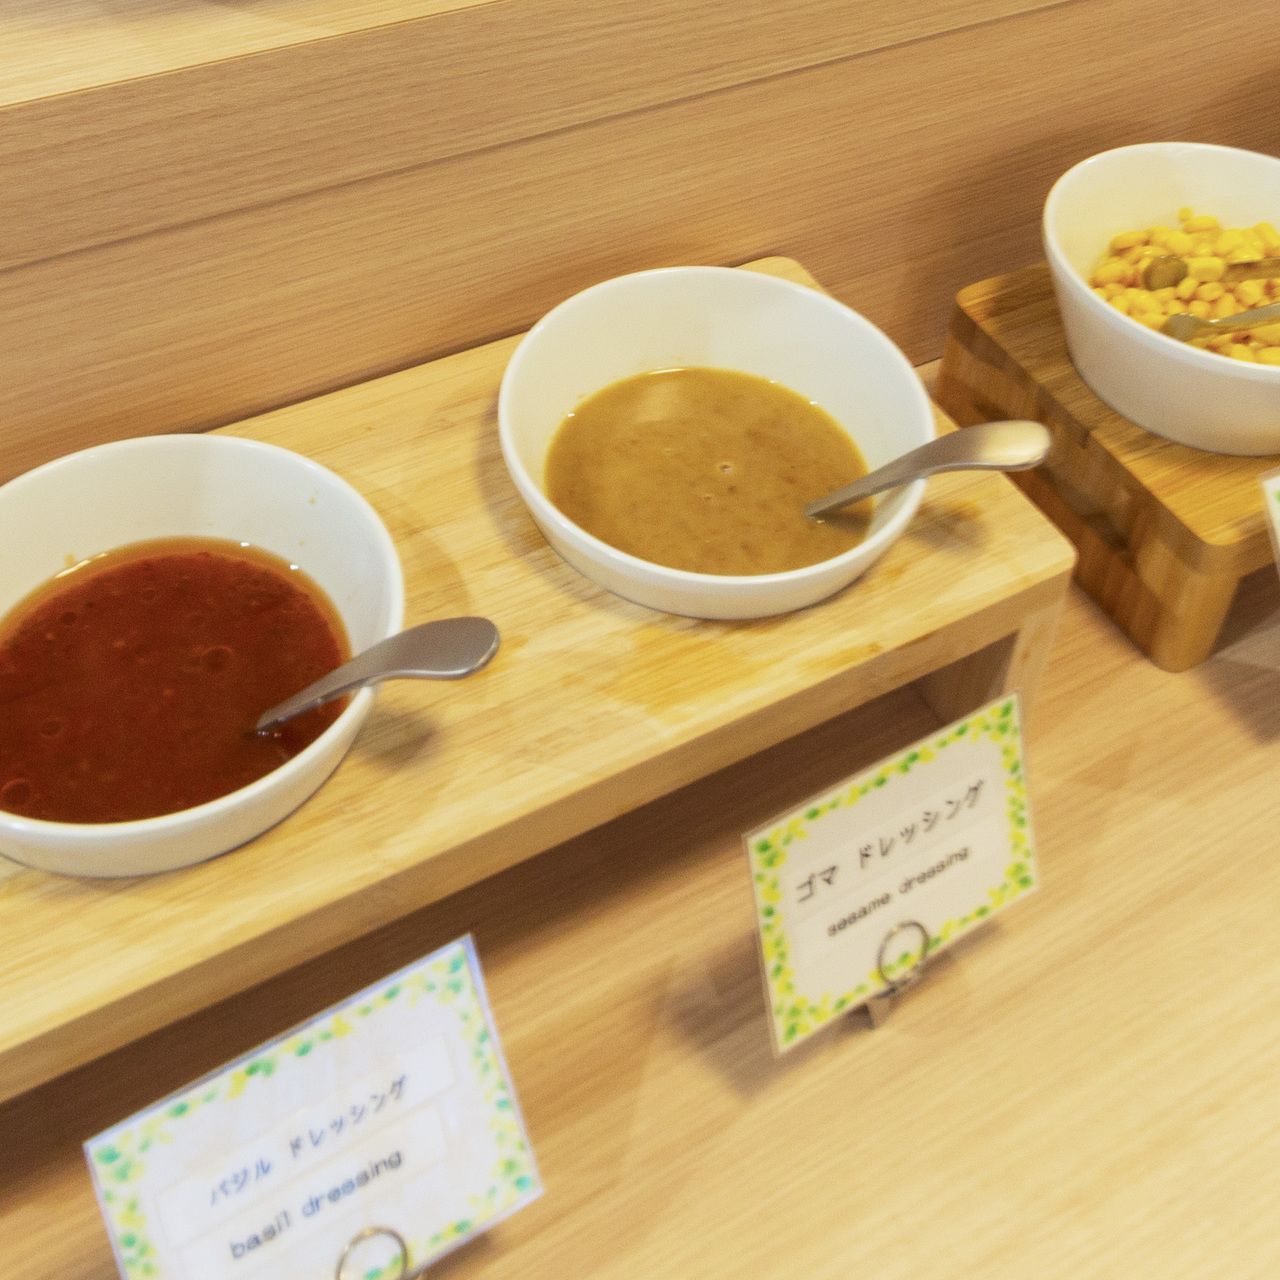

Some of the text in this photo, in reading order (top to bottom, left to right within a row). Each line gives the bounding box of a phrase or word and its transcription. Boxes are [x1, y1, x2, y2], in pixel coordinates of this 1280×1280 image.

[797, 780, 984, 904] ゴマ ドレッシング
[829, 847, 968, 937] sesame dressing
[211, 1075, 406, 1205] バジル ドレッシング
[230, 1151, 403, 1259] basil dressing
